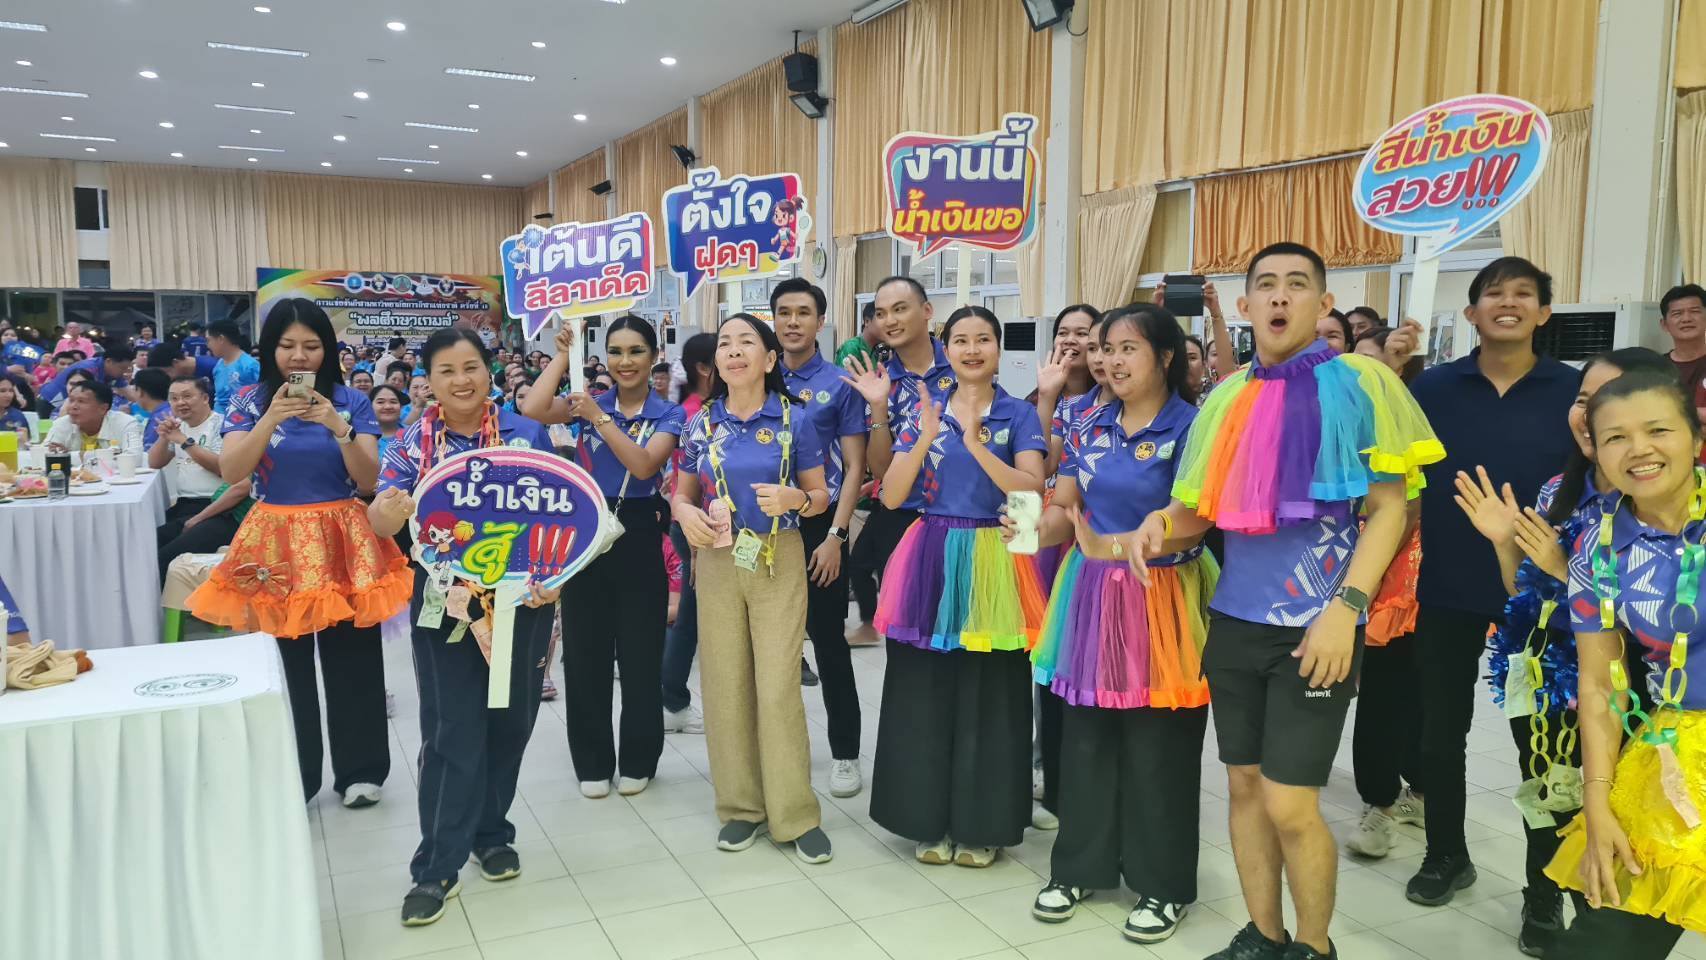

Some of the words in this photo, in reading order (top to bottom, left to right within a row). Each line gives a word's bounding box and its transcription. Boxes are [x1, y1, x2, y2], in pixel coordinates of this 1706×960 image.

[905, 120, 1030, 180] งานนี้
[1374, 111, 1536, 173] สีน้ำเงิน
[681, 171, 773, 234] ตั้งใจ
[894, 188, 1023, 232] น้ำเงินขอ
[528, 218, 643, 275] เต้นดี
[695, 237, 758, 279] ฝุดๆ
[525, 265, 648, 310] ลีลาเด็ด
[446, 460, 573, 513] น้ำเงิน
[1305, 690, 1326, 698] Hurley
